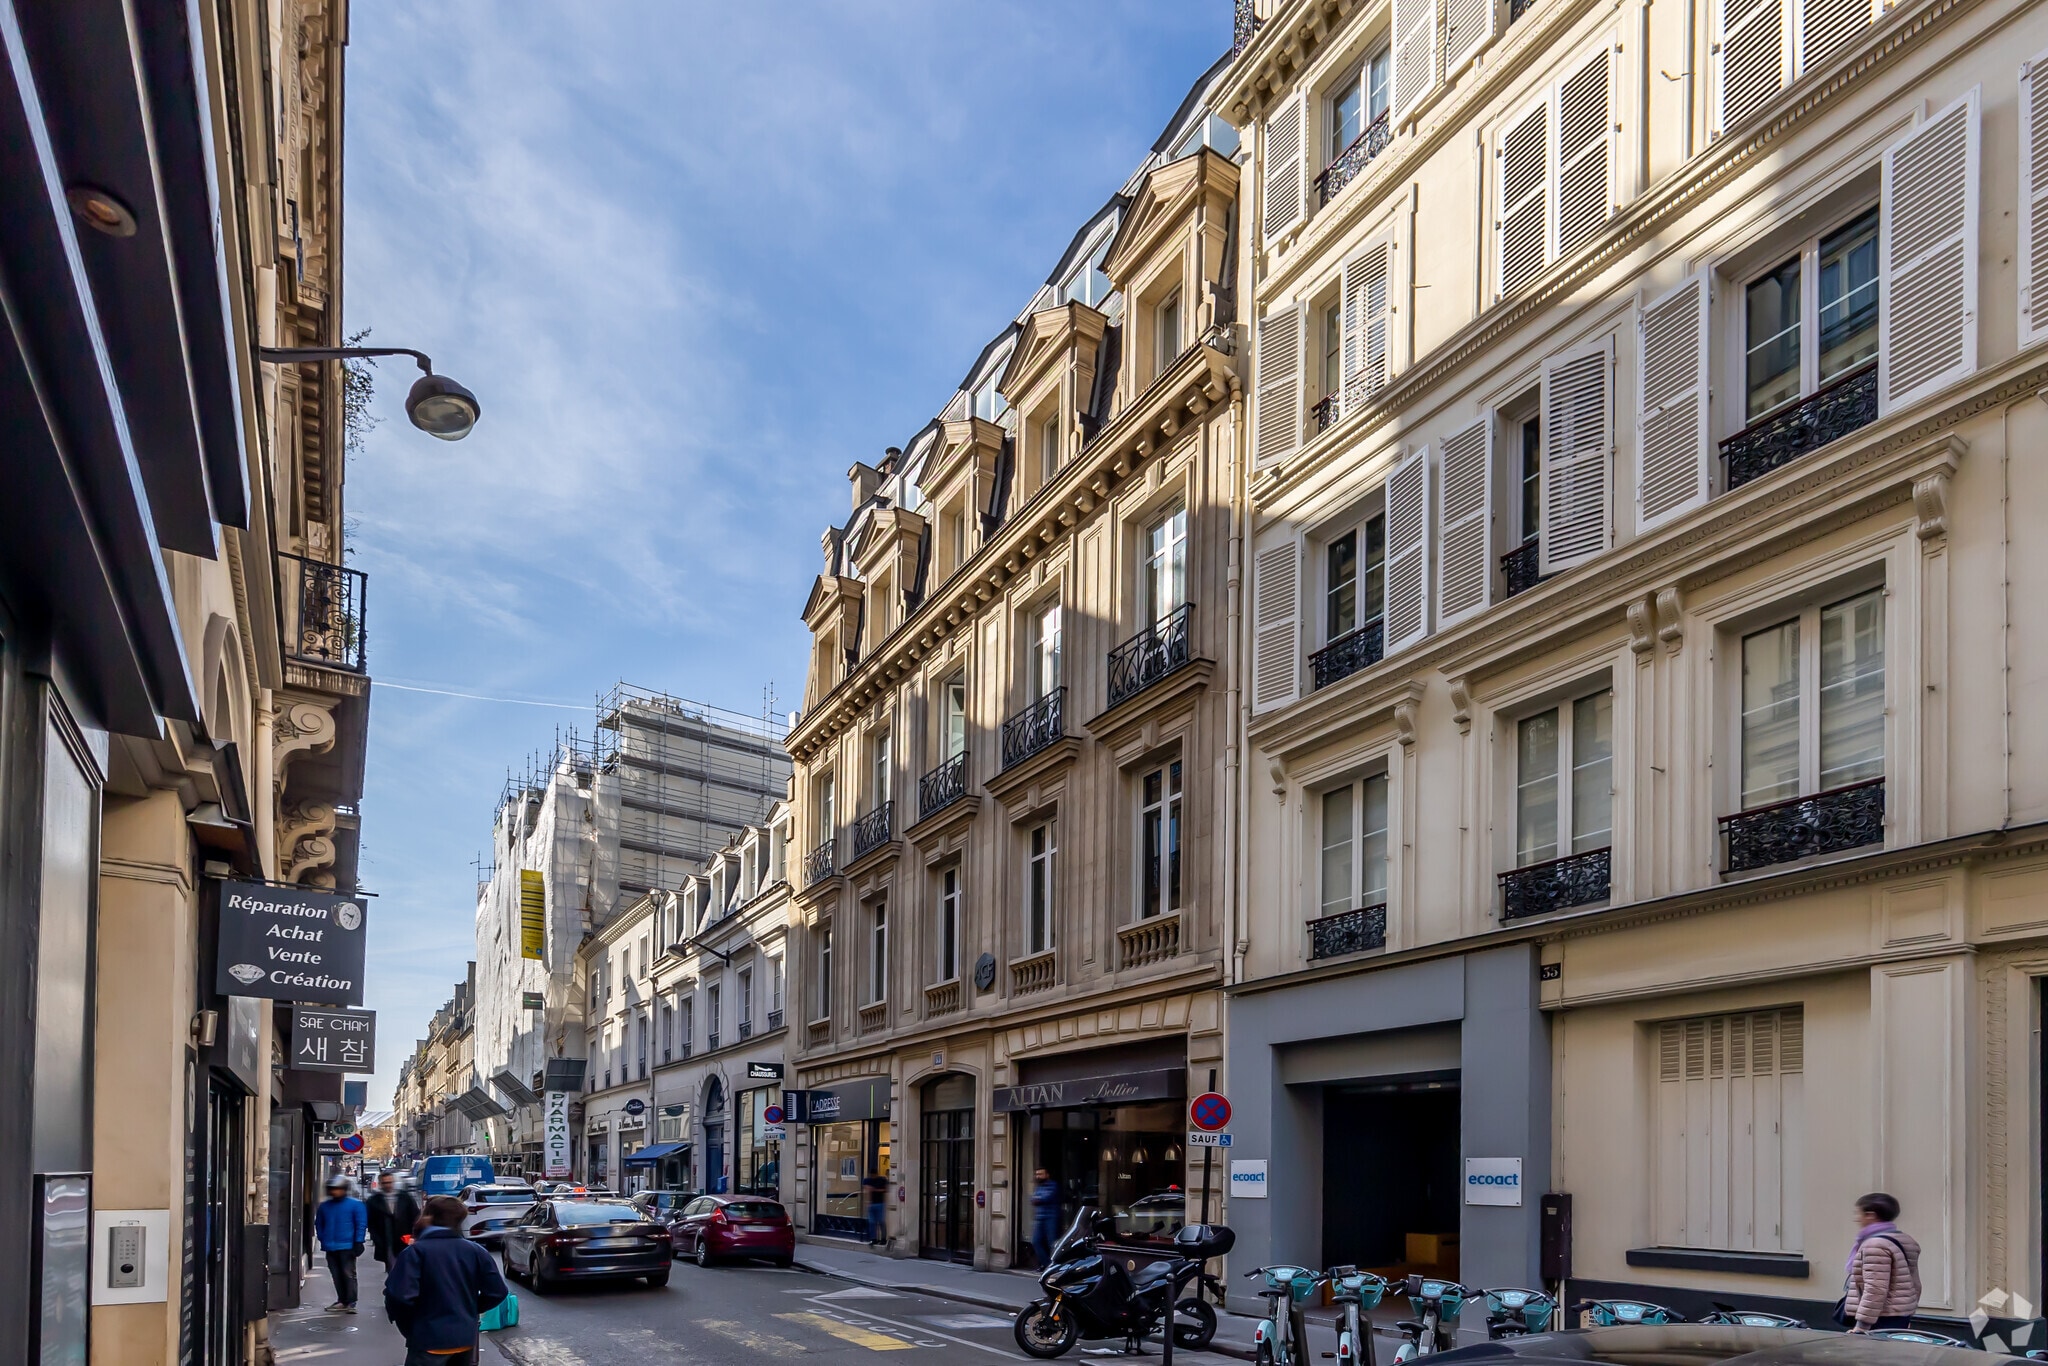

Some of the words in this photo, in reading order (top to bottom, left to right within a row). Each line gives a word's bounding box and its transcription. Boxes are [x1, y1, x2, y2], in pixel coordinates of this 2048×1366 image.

[228, 894, 328, 920] Réparation
[266, 923, 324, 943] Achat
[268, 946, 322, 965] Vente
[269, 970, 352, 990] Création
[299, 1016, 325, 1030] SAE
[330, 1019, 370, 1032] CHAM
[1008, 1083, 1064, 1107] ALTAN
[548, 1093, 566, 1166] PHARMACIE
[1191, 1134, 1218, 1144] SAUF
[1232, 1171, 1265, 1182] ecoact
[1468, 1173, 1519, 1186] ecoact
